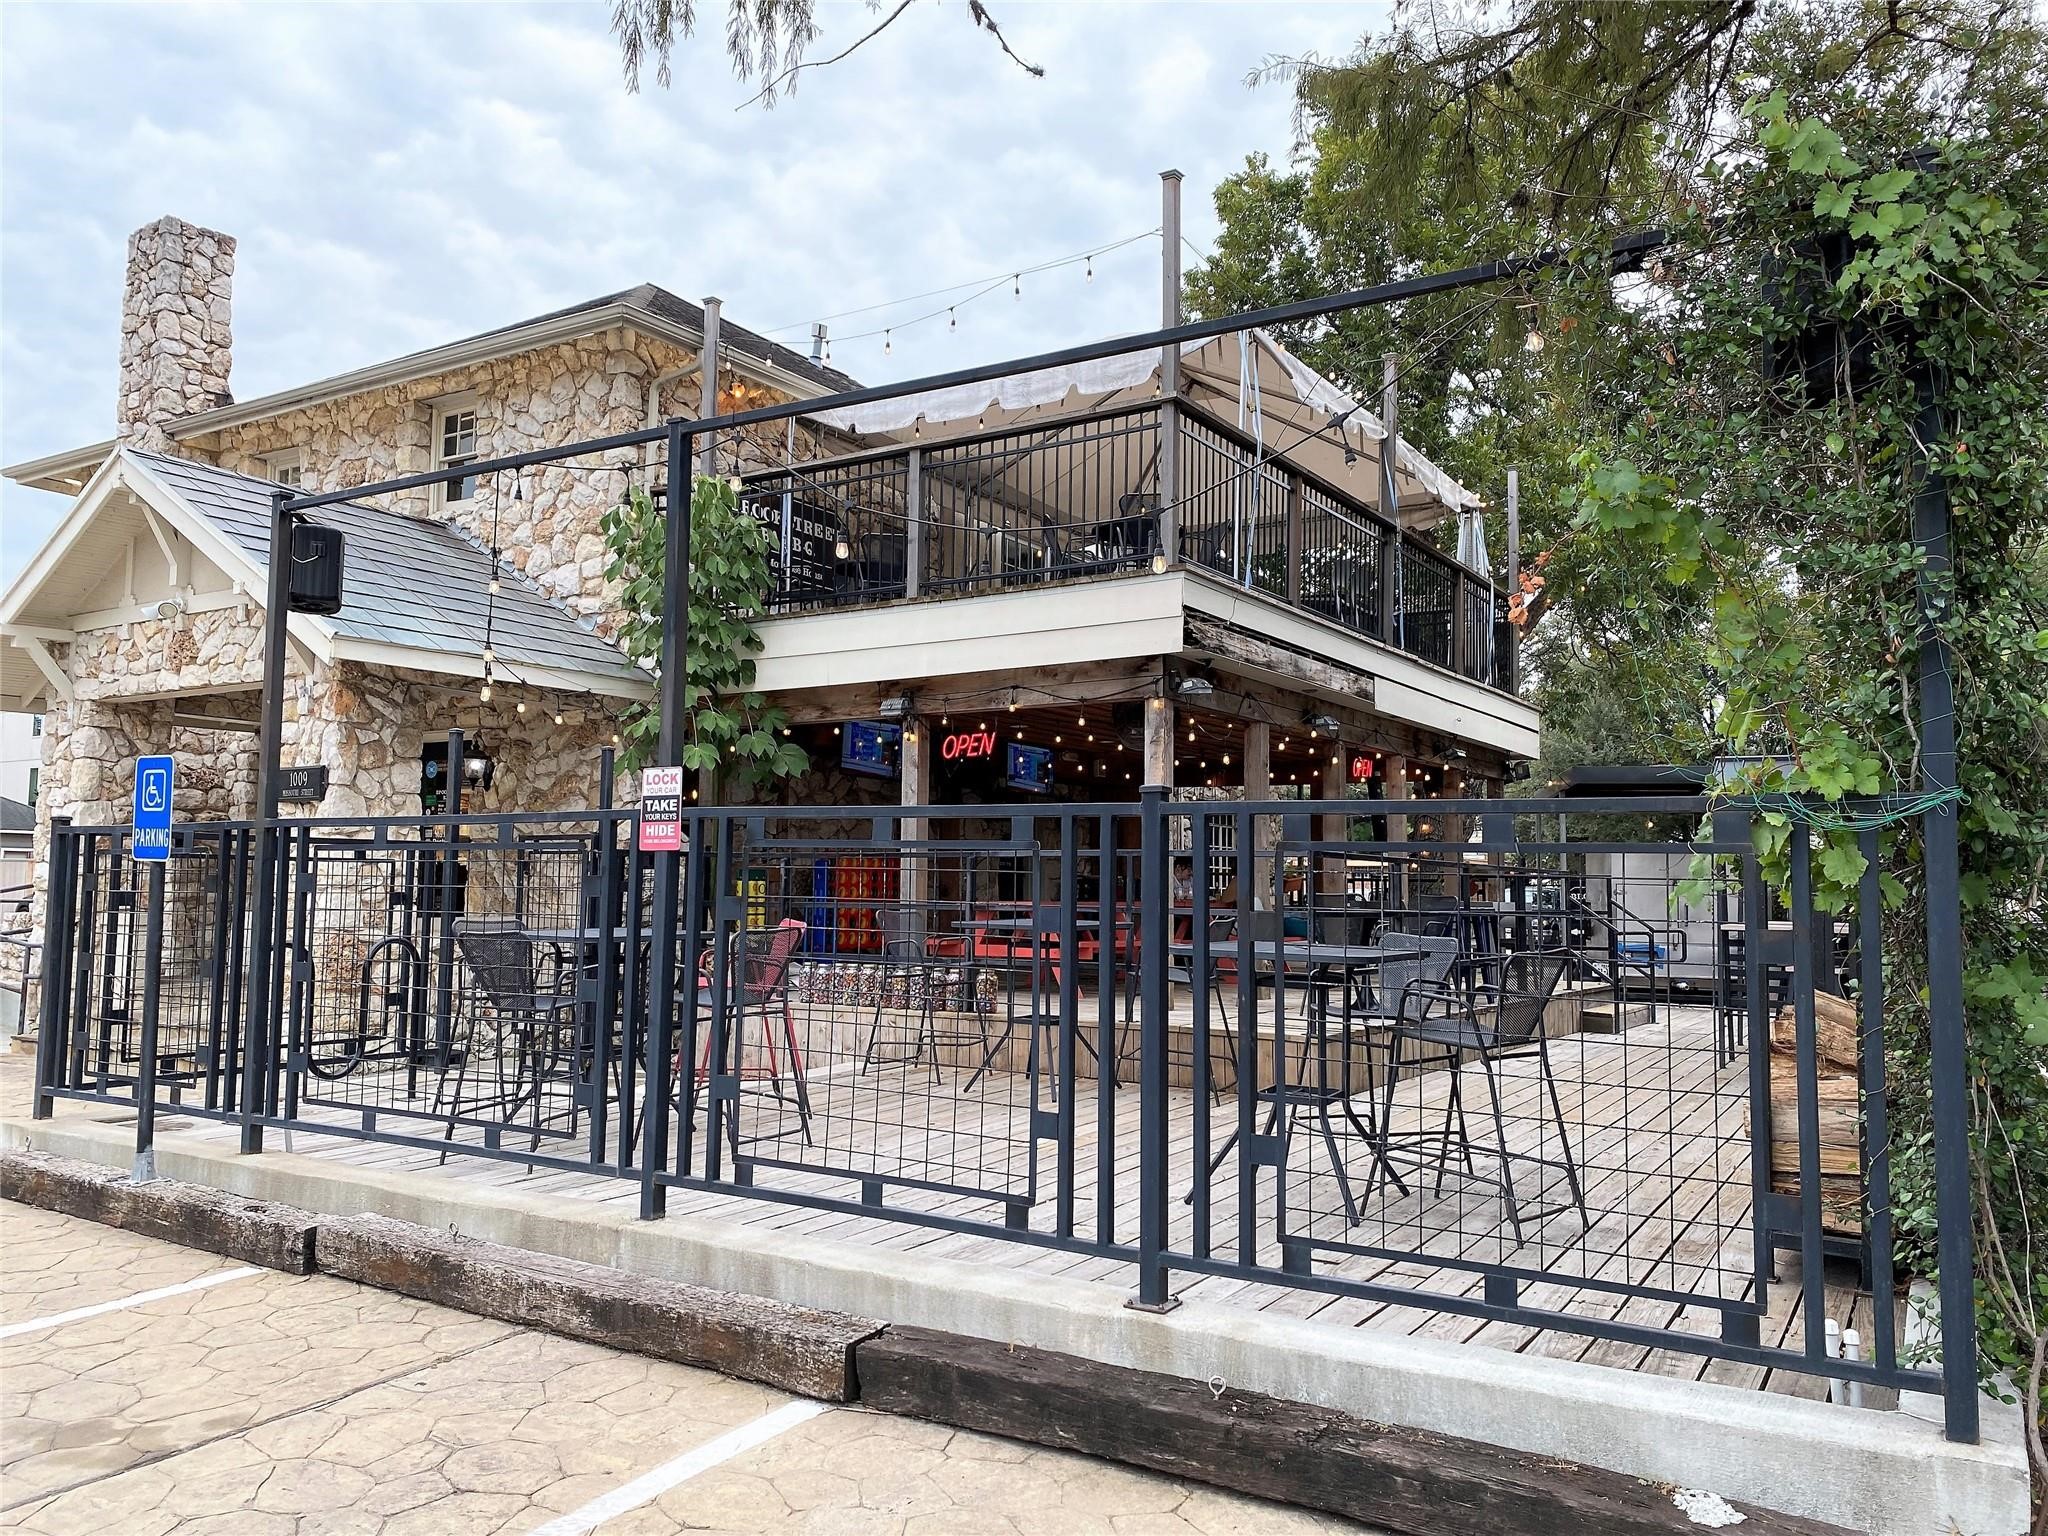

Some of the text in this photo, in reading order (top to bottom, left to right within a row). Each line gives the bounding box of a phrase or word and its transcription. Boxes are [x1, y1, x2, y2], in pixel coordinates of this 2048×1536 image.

[942, 731, 996, 760] OPEN
[1353, 757, 1373, 777] OPEN
[290, 771, 308, 787] 1009
[646, 773, 679, 786] LOCK
[664, 786, 677, 794] CAR
[645, 799, 678, 812] TAKE
[661, 812, 677, 820] KEYS
[645, 824, 676, 837] HIDE
[135, 828, 169, 848] PARKING
